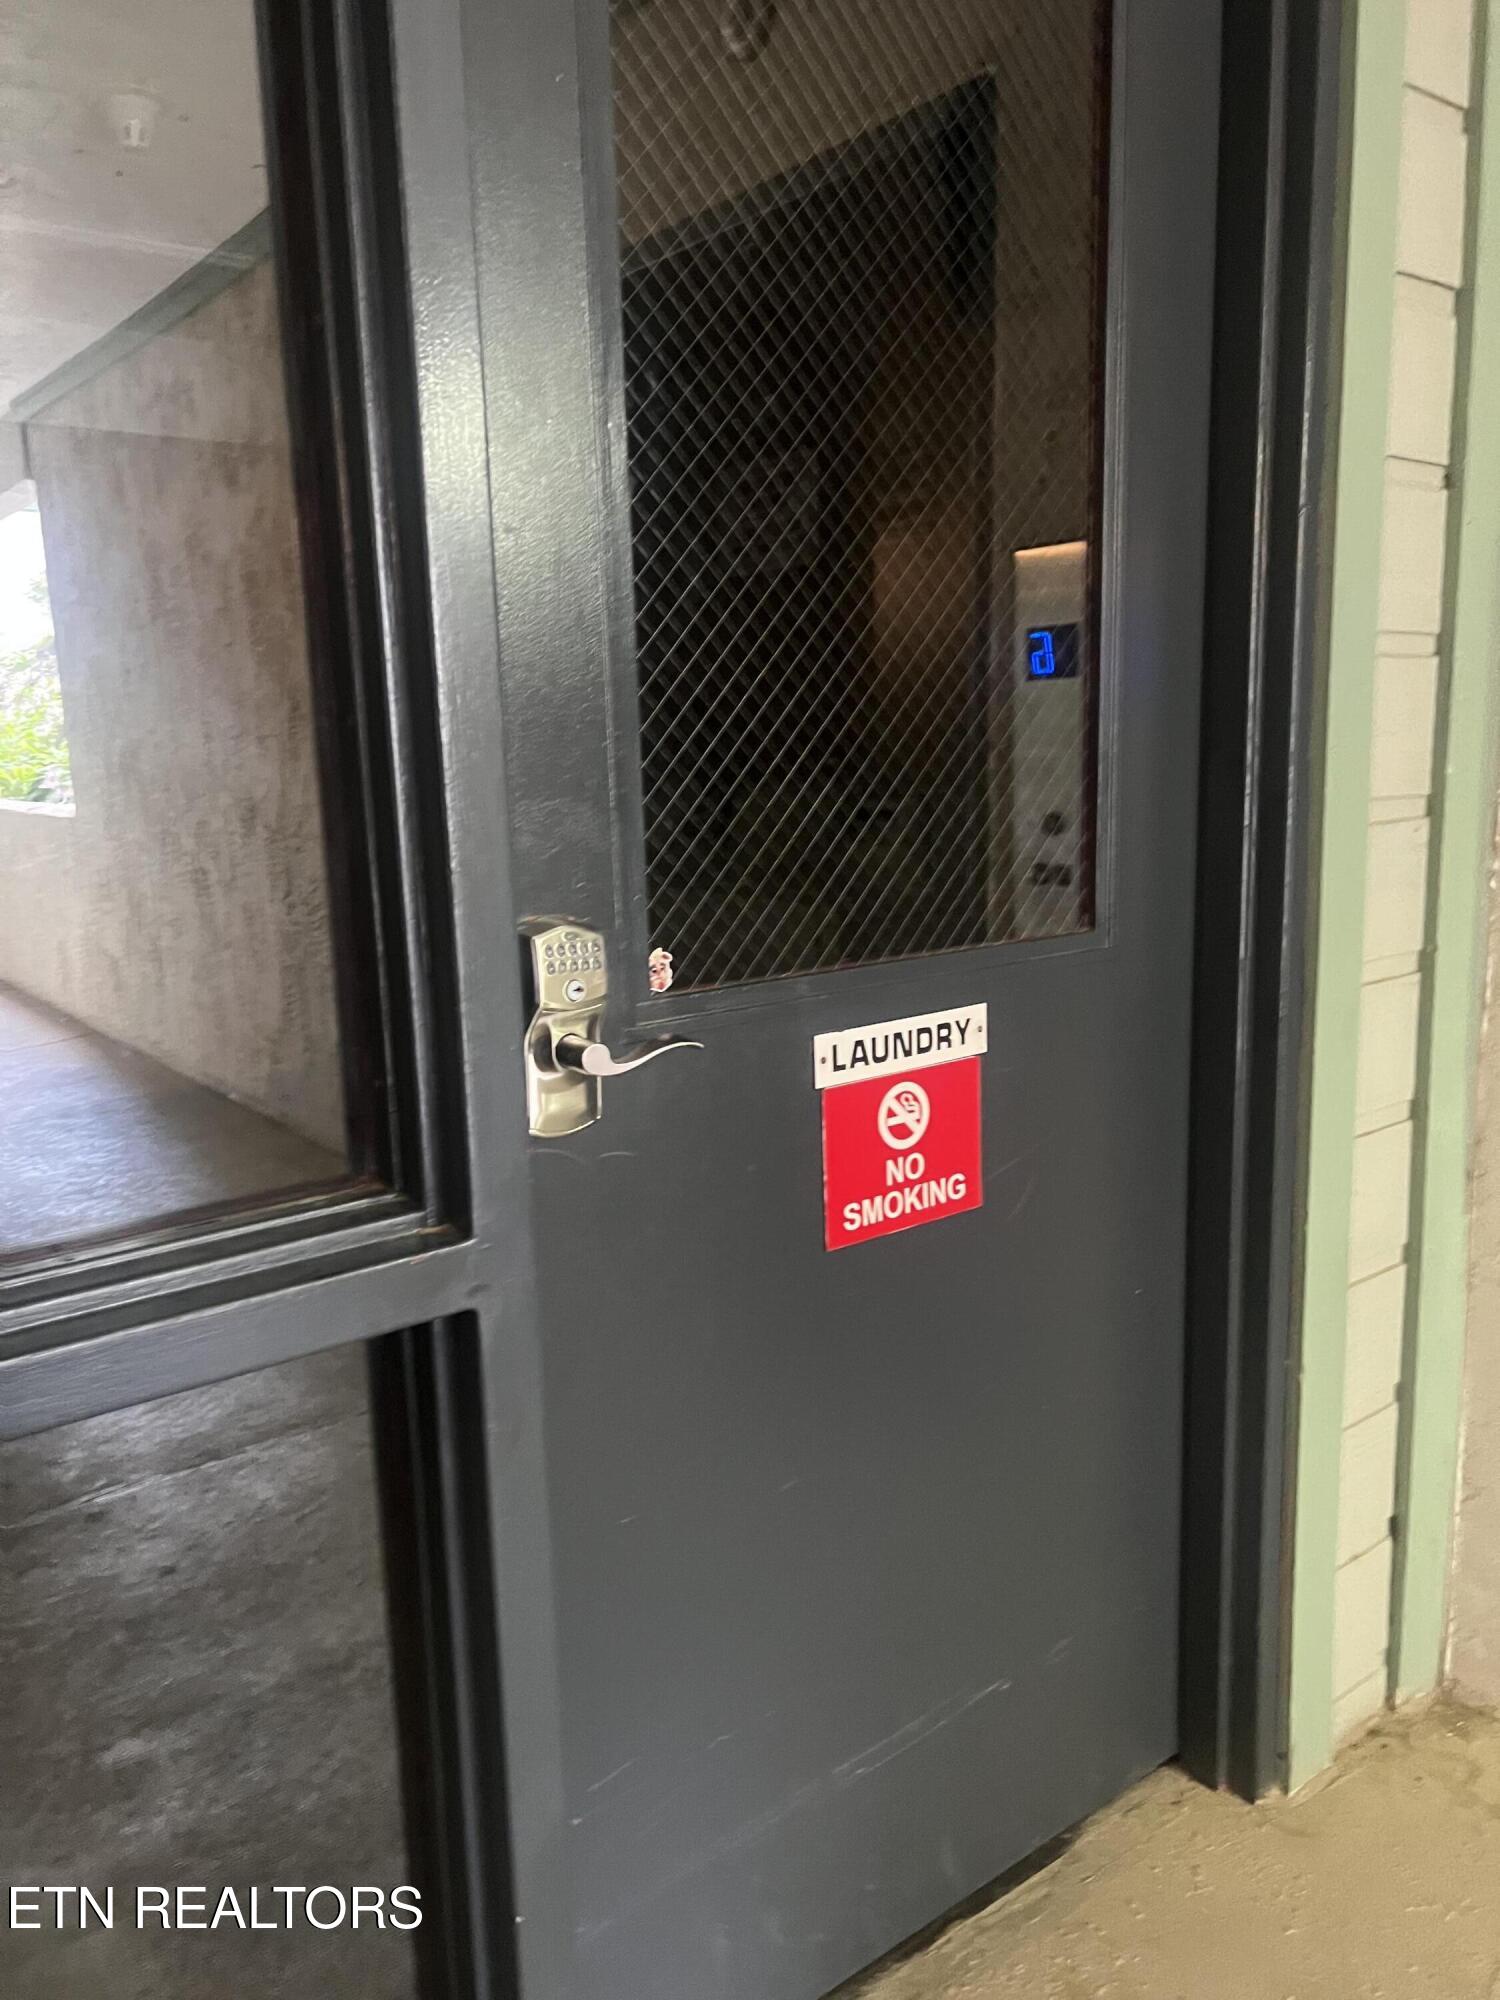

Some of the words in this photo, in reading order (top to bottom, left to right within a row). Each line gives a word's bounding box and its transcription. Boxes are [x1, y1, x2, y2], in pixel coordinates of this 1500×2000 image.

[832, 1018, 971, 1072] LAUNDRY
[885, 1152, 925, 1186] NO
[843, 1173, 967, 1231] SMOKING
